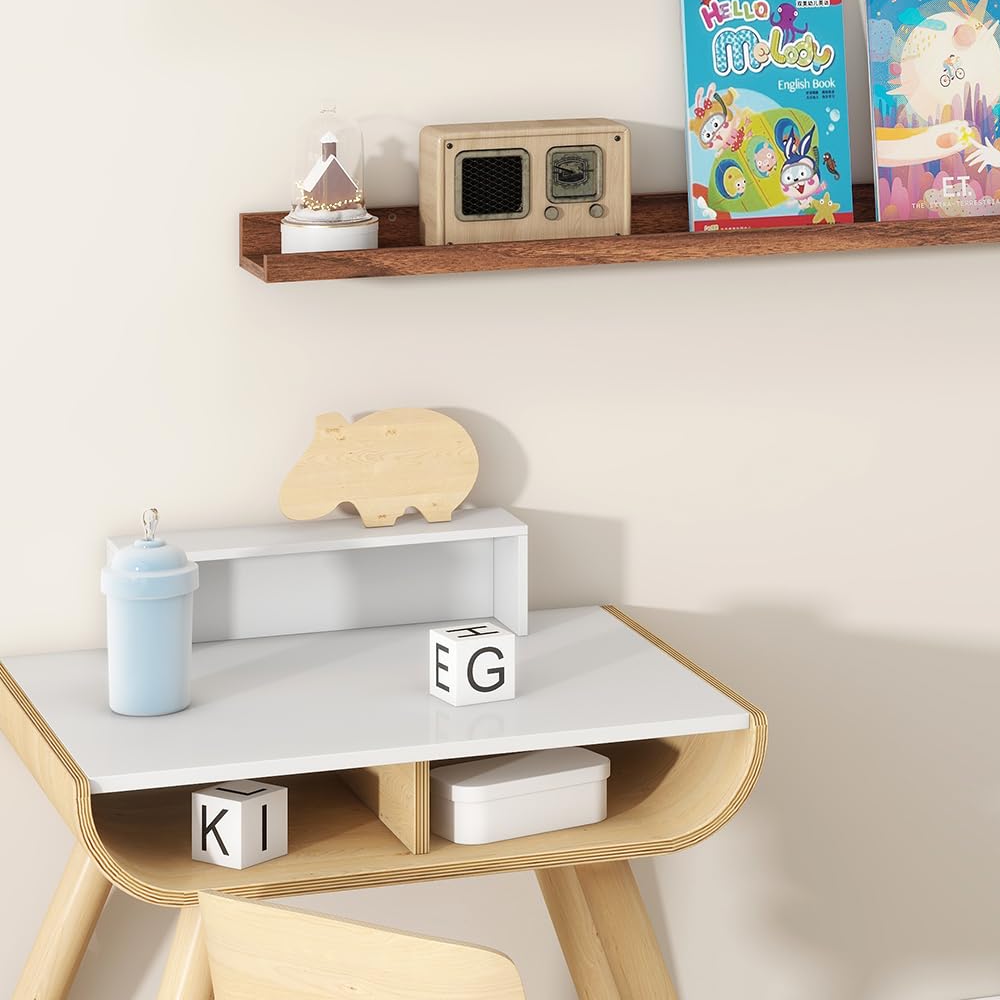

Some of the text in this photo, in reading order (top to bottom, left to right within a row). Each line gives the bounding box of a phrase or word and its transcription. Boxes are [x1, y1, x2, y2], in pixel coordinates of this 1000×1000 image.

[701, 0, 769, 30] HELLO
[778, 77, 836, 93] English Book
[942, 175, 973, 197] E.T.
[435, 642, 450, 693] E
[466, 646, 505, 693] G
[201, 804, 230, 857] K
[261, 803, 268, 852] I
